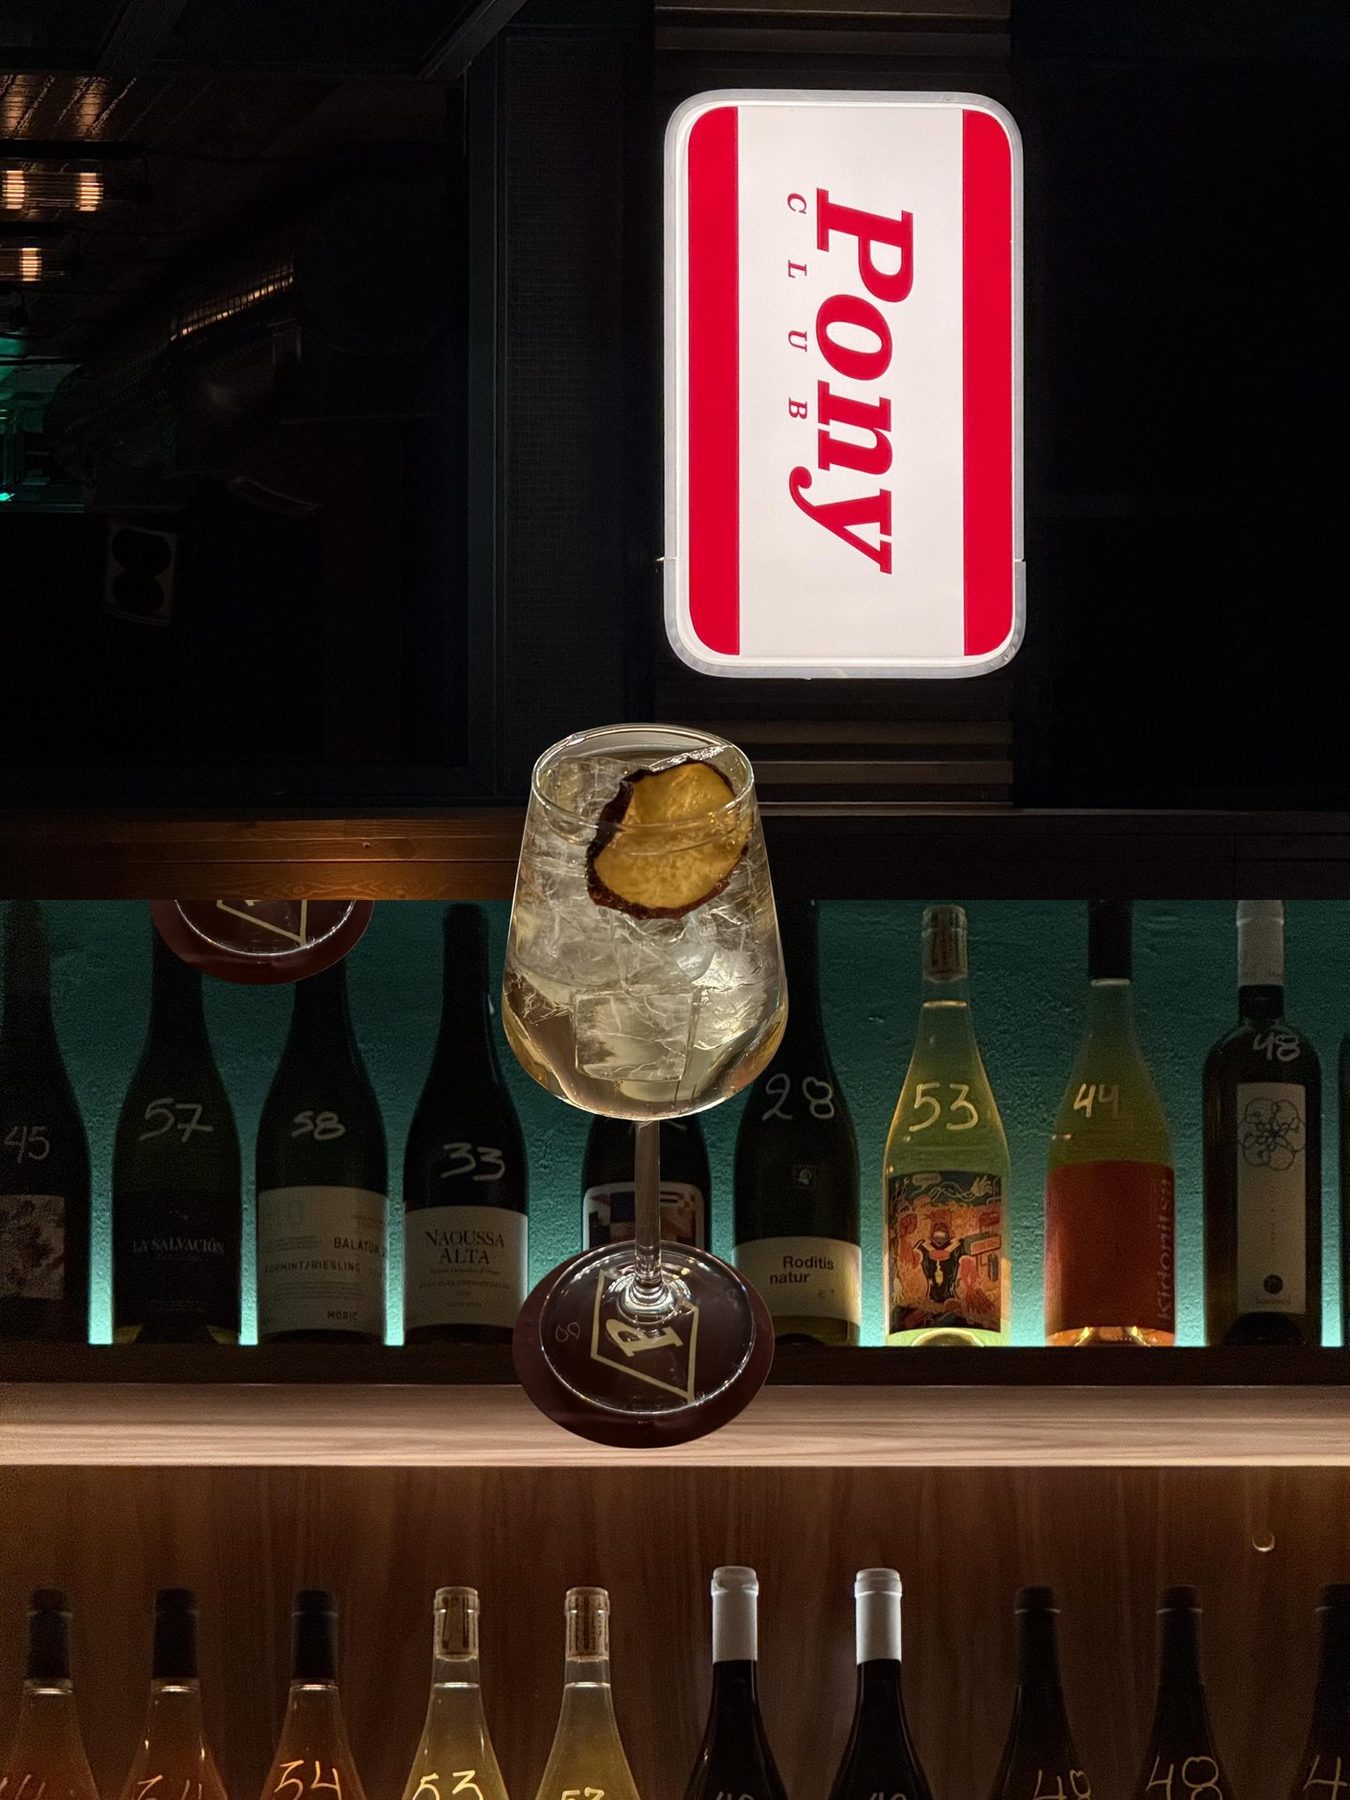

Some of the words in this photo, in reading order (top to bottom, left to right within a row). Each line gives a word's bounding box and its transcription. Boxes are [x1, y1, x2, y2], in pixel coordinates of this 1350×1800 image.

[787, 193, 808, 420] CLUB
[789, 187, 914, 575] Pony
[1252, 1031, 1301, 1063] 48
[762, 1073, 837, 1121] 28
[909, 1082, 979, 1132] 53
[1072, 1083, 1120, 1118] 44
[138, 1098, 213, 1143] 57
[4, 1126, 50, 1164] 45
[440, 1142, 507, 1182] 33
[425, 1229, 505, 1248] NAOUSSA
[440, 1247, 490, 1265] ALTA
[769, 1271, 809, 1285] natur
[783, 1256, 834, 1270] Roditis
